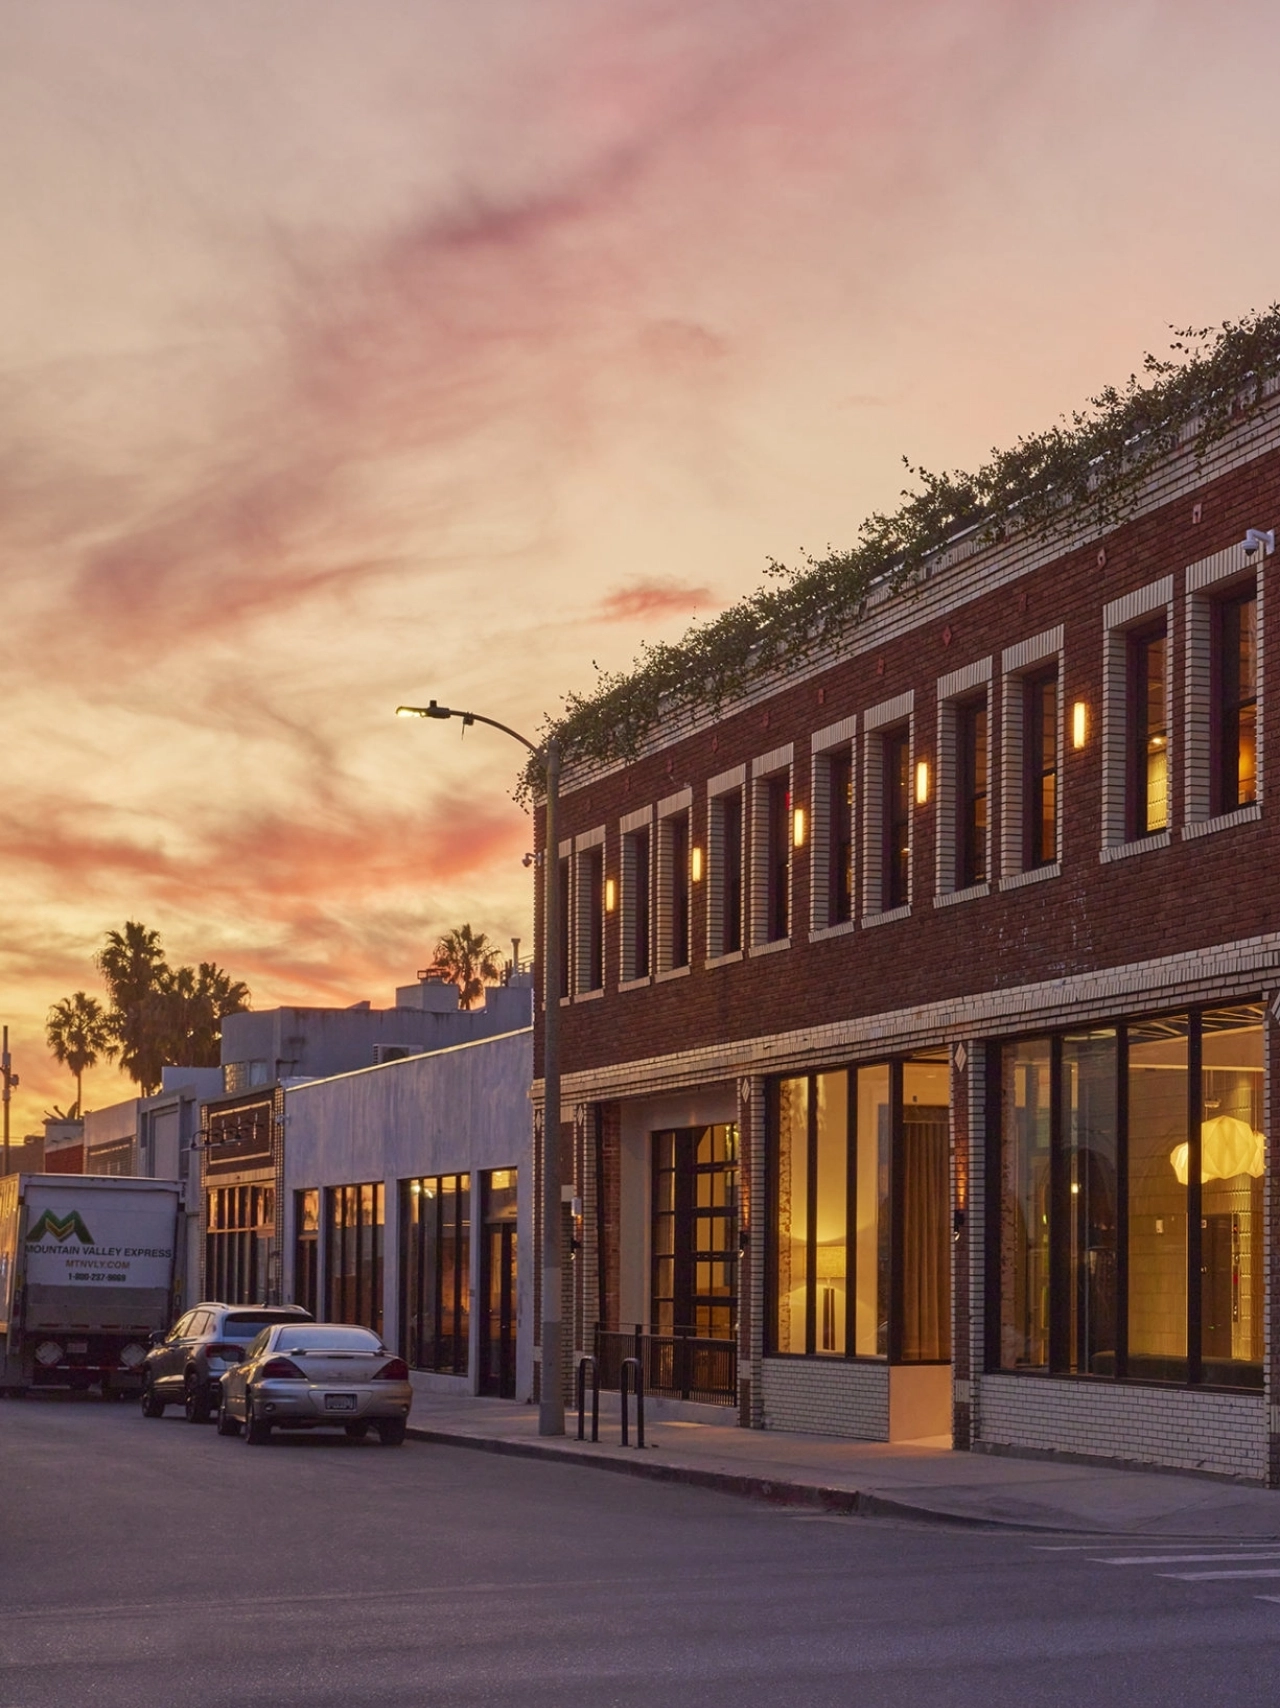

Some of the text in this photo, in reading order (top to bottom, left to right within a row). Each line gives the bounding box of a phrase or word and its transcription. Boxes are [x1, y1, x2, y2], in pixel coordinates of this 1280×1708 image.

[26, 1244, 173, 1259] MOUNTAIN VALLEY EXPRESS
[66, 1259, 130, 1269] MTNVLY.COM
